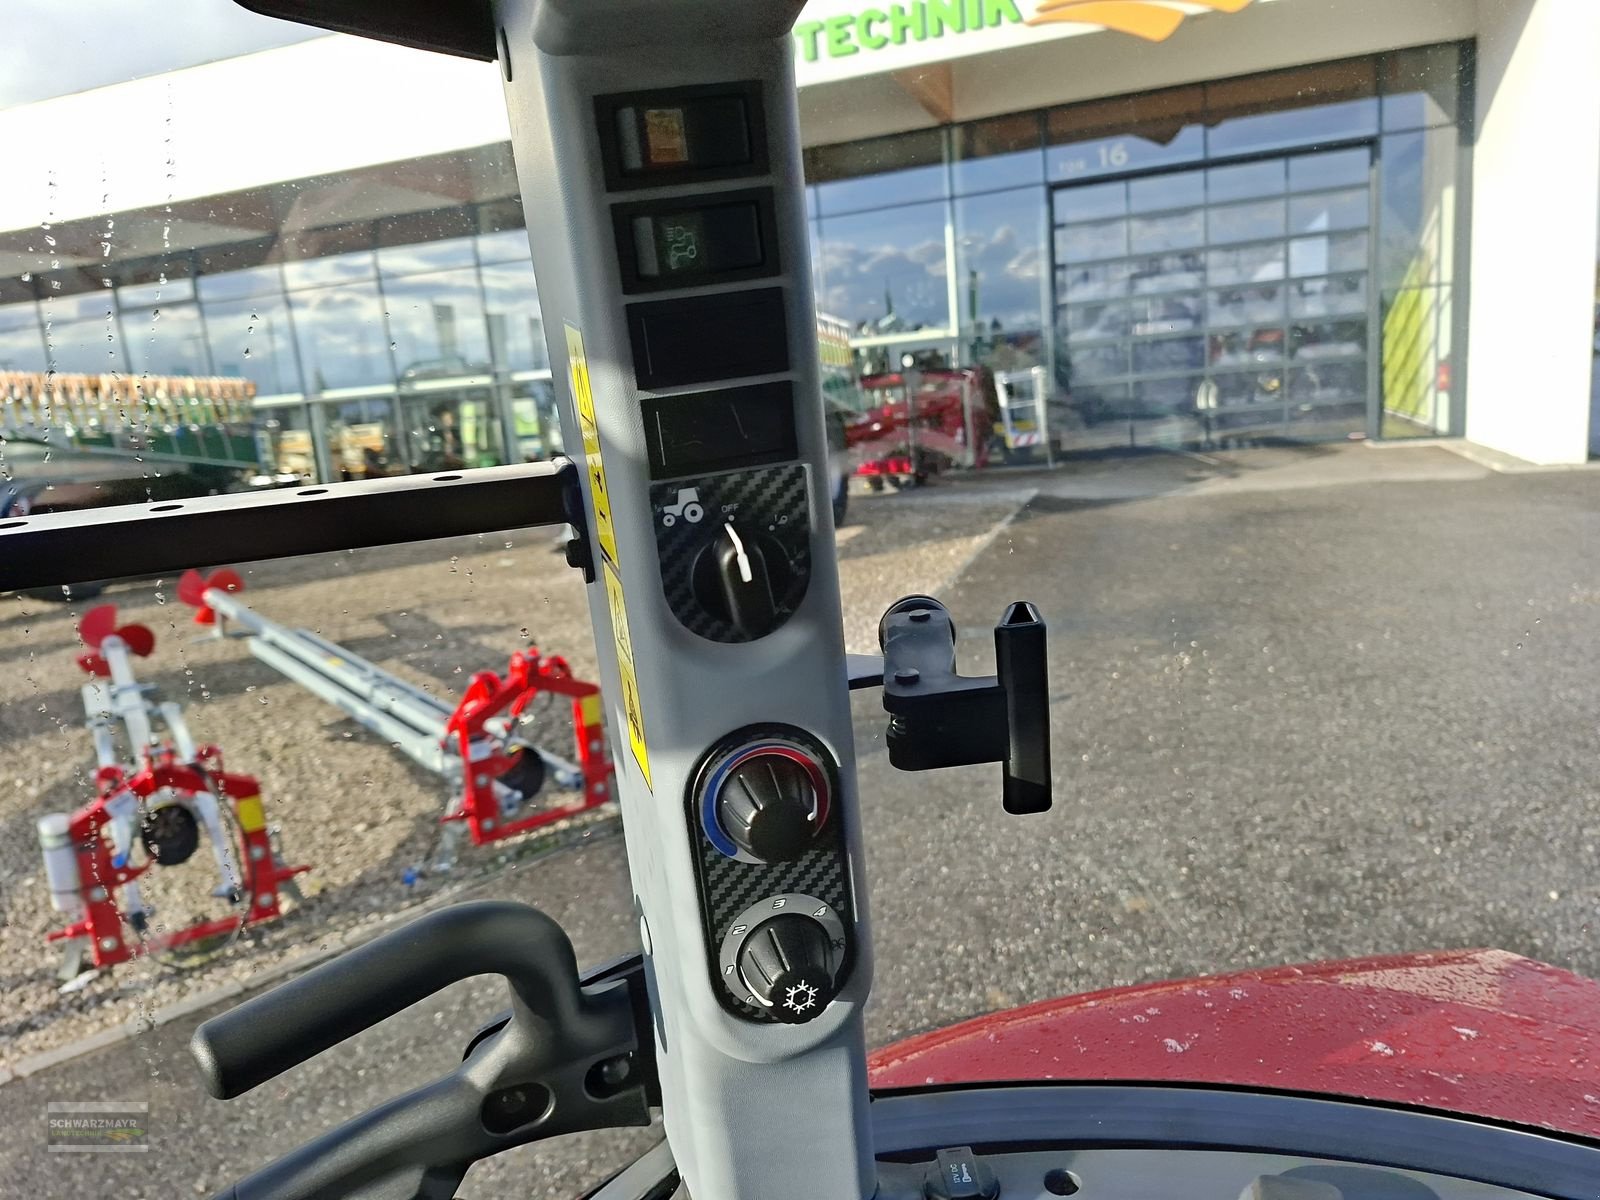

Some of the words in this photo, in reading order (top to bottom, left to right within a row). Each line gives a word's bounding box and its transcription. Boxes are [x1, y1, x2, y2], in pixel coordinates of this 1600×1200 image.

[795, 0, 1023, 62] TECHNIK
[1098, 143, 1128, 168] 16
[721, 503, 740, 513] OFF
[772, 898, 786, 909] 3
[813, 906, 827, 917] 4
[732, 925, 747, 935] 2
[725, 965, 734, 975] 1
